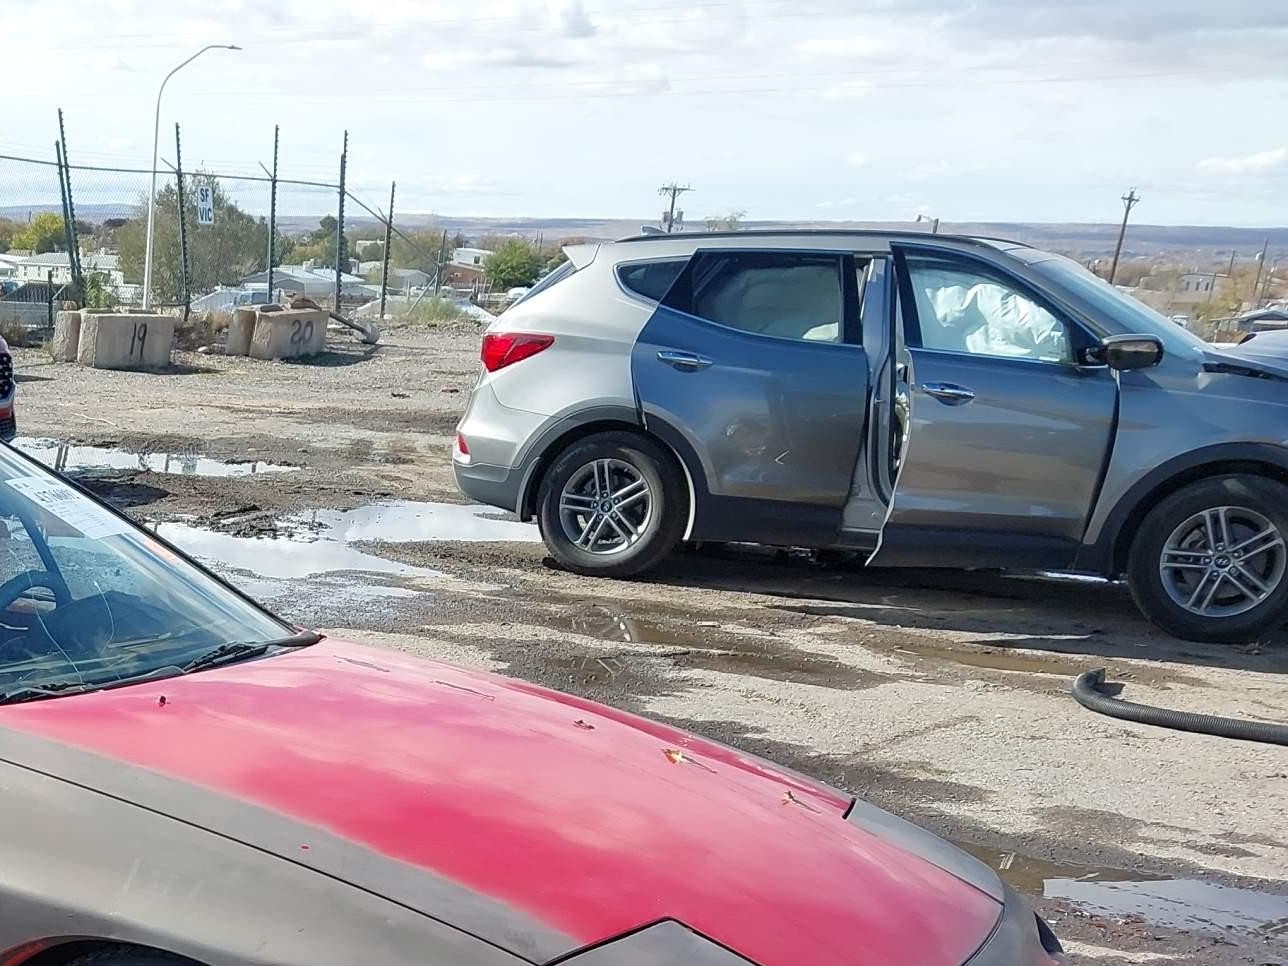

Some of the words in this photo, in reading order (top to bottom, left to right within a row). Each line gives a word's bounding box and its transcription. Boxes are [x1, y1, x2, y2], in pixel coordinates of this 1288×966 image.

[200, 187, 210, 202] SF
[198, 206, 213, 221] VIC
[128, 321, 148, 361] 19
[290, 319, 313, 346] 20
